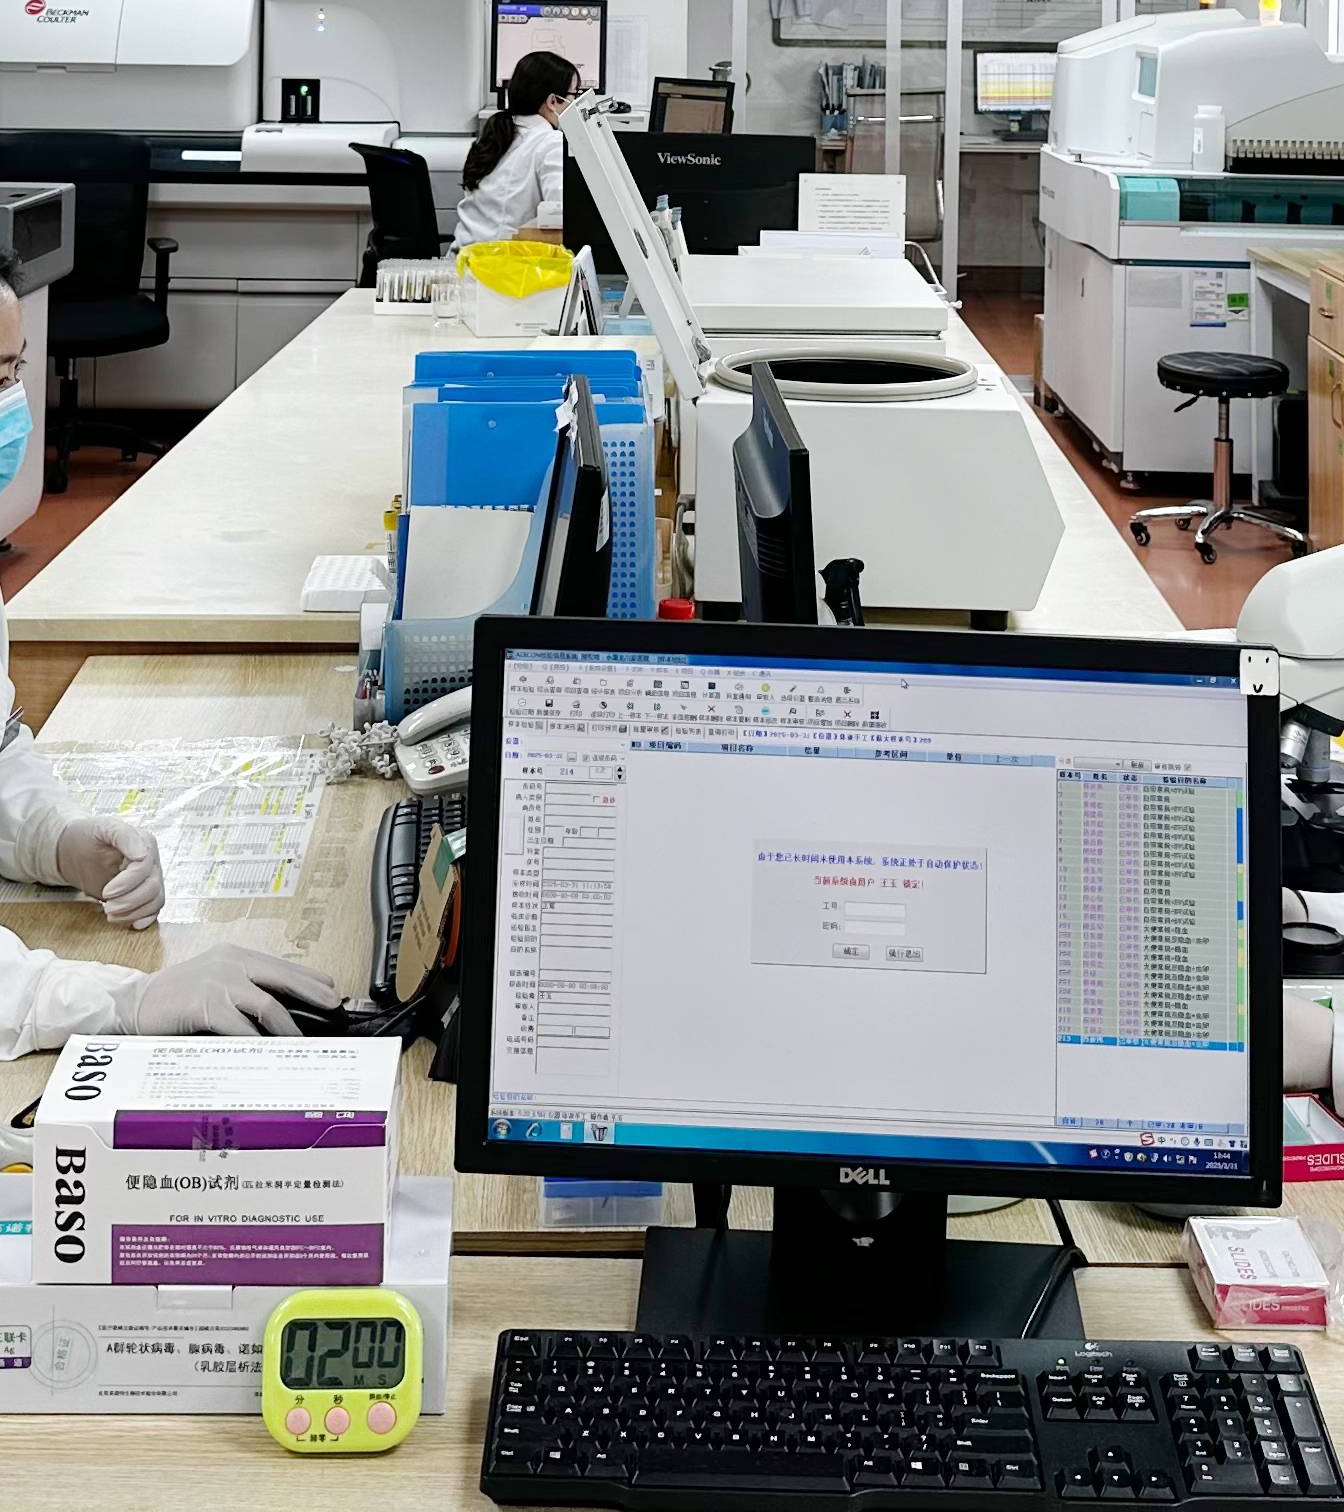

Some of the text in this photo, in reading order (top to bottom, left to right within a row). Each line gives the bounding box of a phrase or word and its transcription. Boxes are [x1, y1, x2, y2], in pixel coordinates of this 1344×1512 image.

[46, 8, 89, 16] BECKMAN
[37, 15, 76, 23] COULTER
[657, 152, 721, 165] ViewSonic
[65, 1042, 120, 1101] Baso
[840, 1167, 890, 1185] DELL
[126, 1174, 239, 1192] 便隐血(OB)试剂
[55, 1144, 86, 1264] Baso
[169, 1215, 324, 1223] FOR IN VITRO DIAGNOSTIC USE
[1228, 1246, 1258, 1280] SLIDES
[1075, 1350, 1112, 1358] Logitech
[354, 1375, 387, 1386] M S
[295, 1394, 344, 1405] 分 秒
